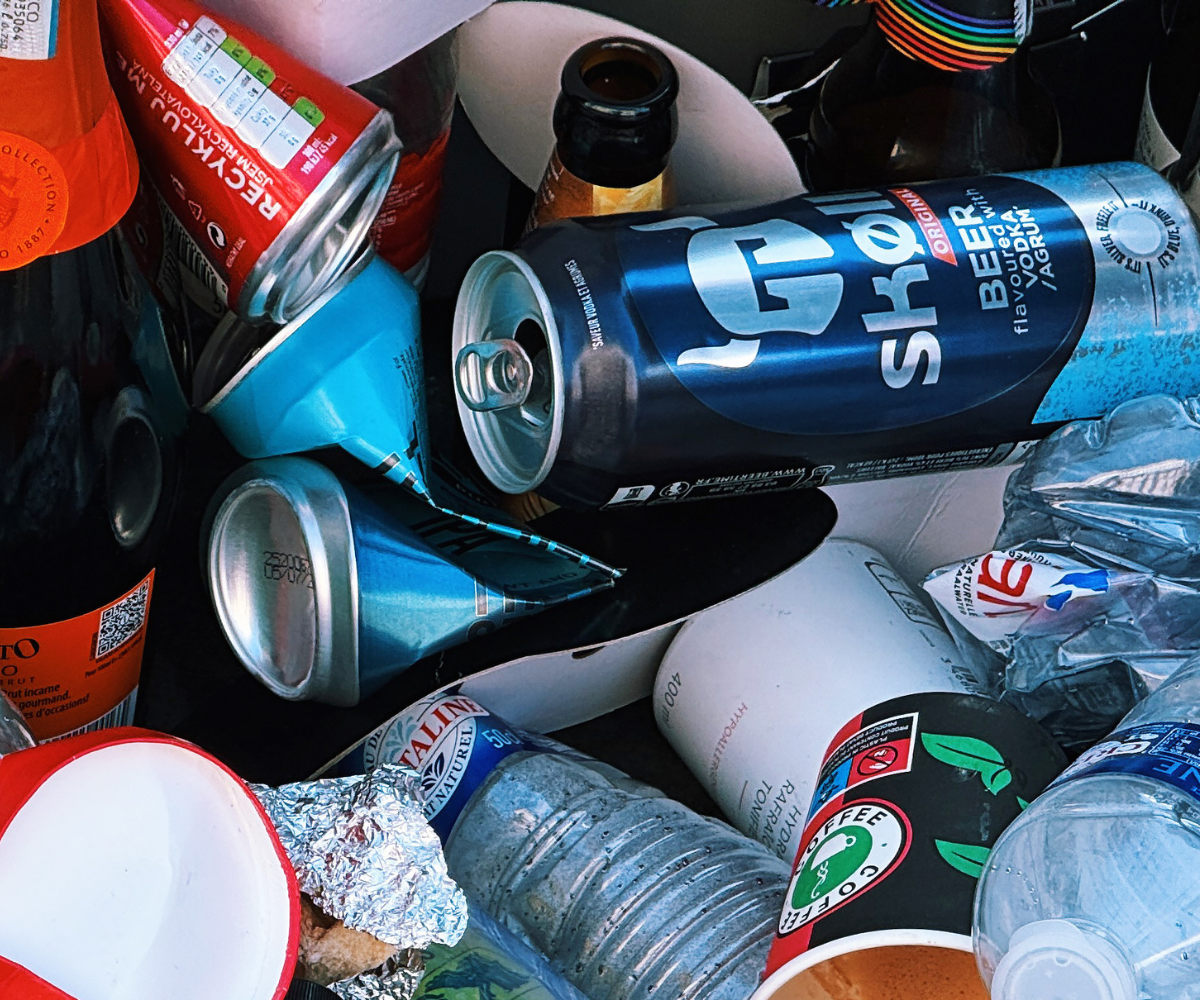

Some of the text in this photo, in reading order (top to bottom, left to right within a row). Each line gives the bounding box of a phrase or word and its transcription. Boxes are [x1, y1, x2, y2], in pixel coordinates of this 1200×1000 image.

[146, 94, 281, 221] RECYKLUJ
[234, 153, 274, 190] JSEM
[16, 226, 45, 254] 1887
[896, 187, 950, 254] ORIGINAL
[948, 203, 1009, 310] BEER
[1001, 209, 1038, 288] VODKA
[578, 293, 597, 318] VODKA
[990, 224, 1028, 333] flavoured
[655, 672, 683, 707] 400
[436, 724, 473, 803] NATUREL
